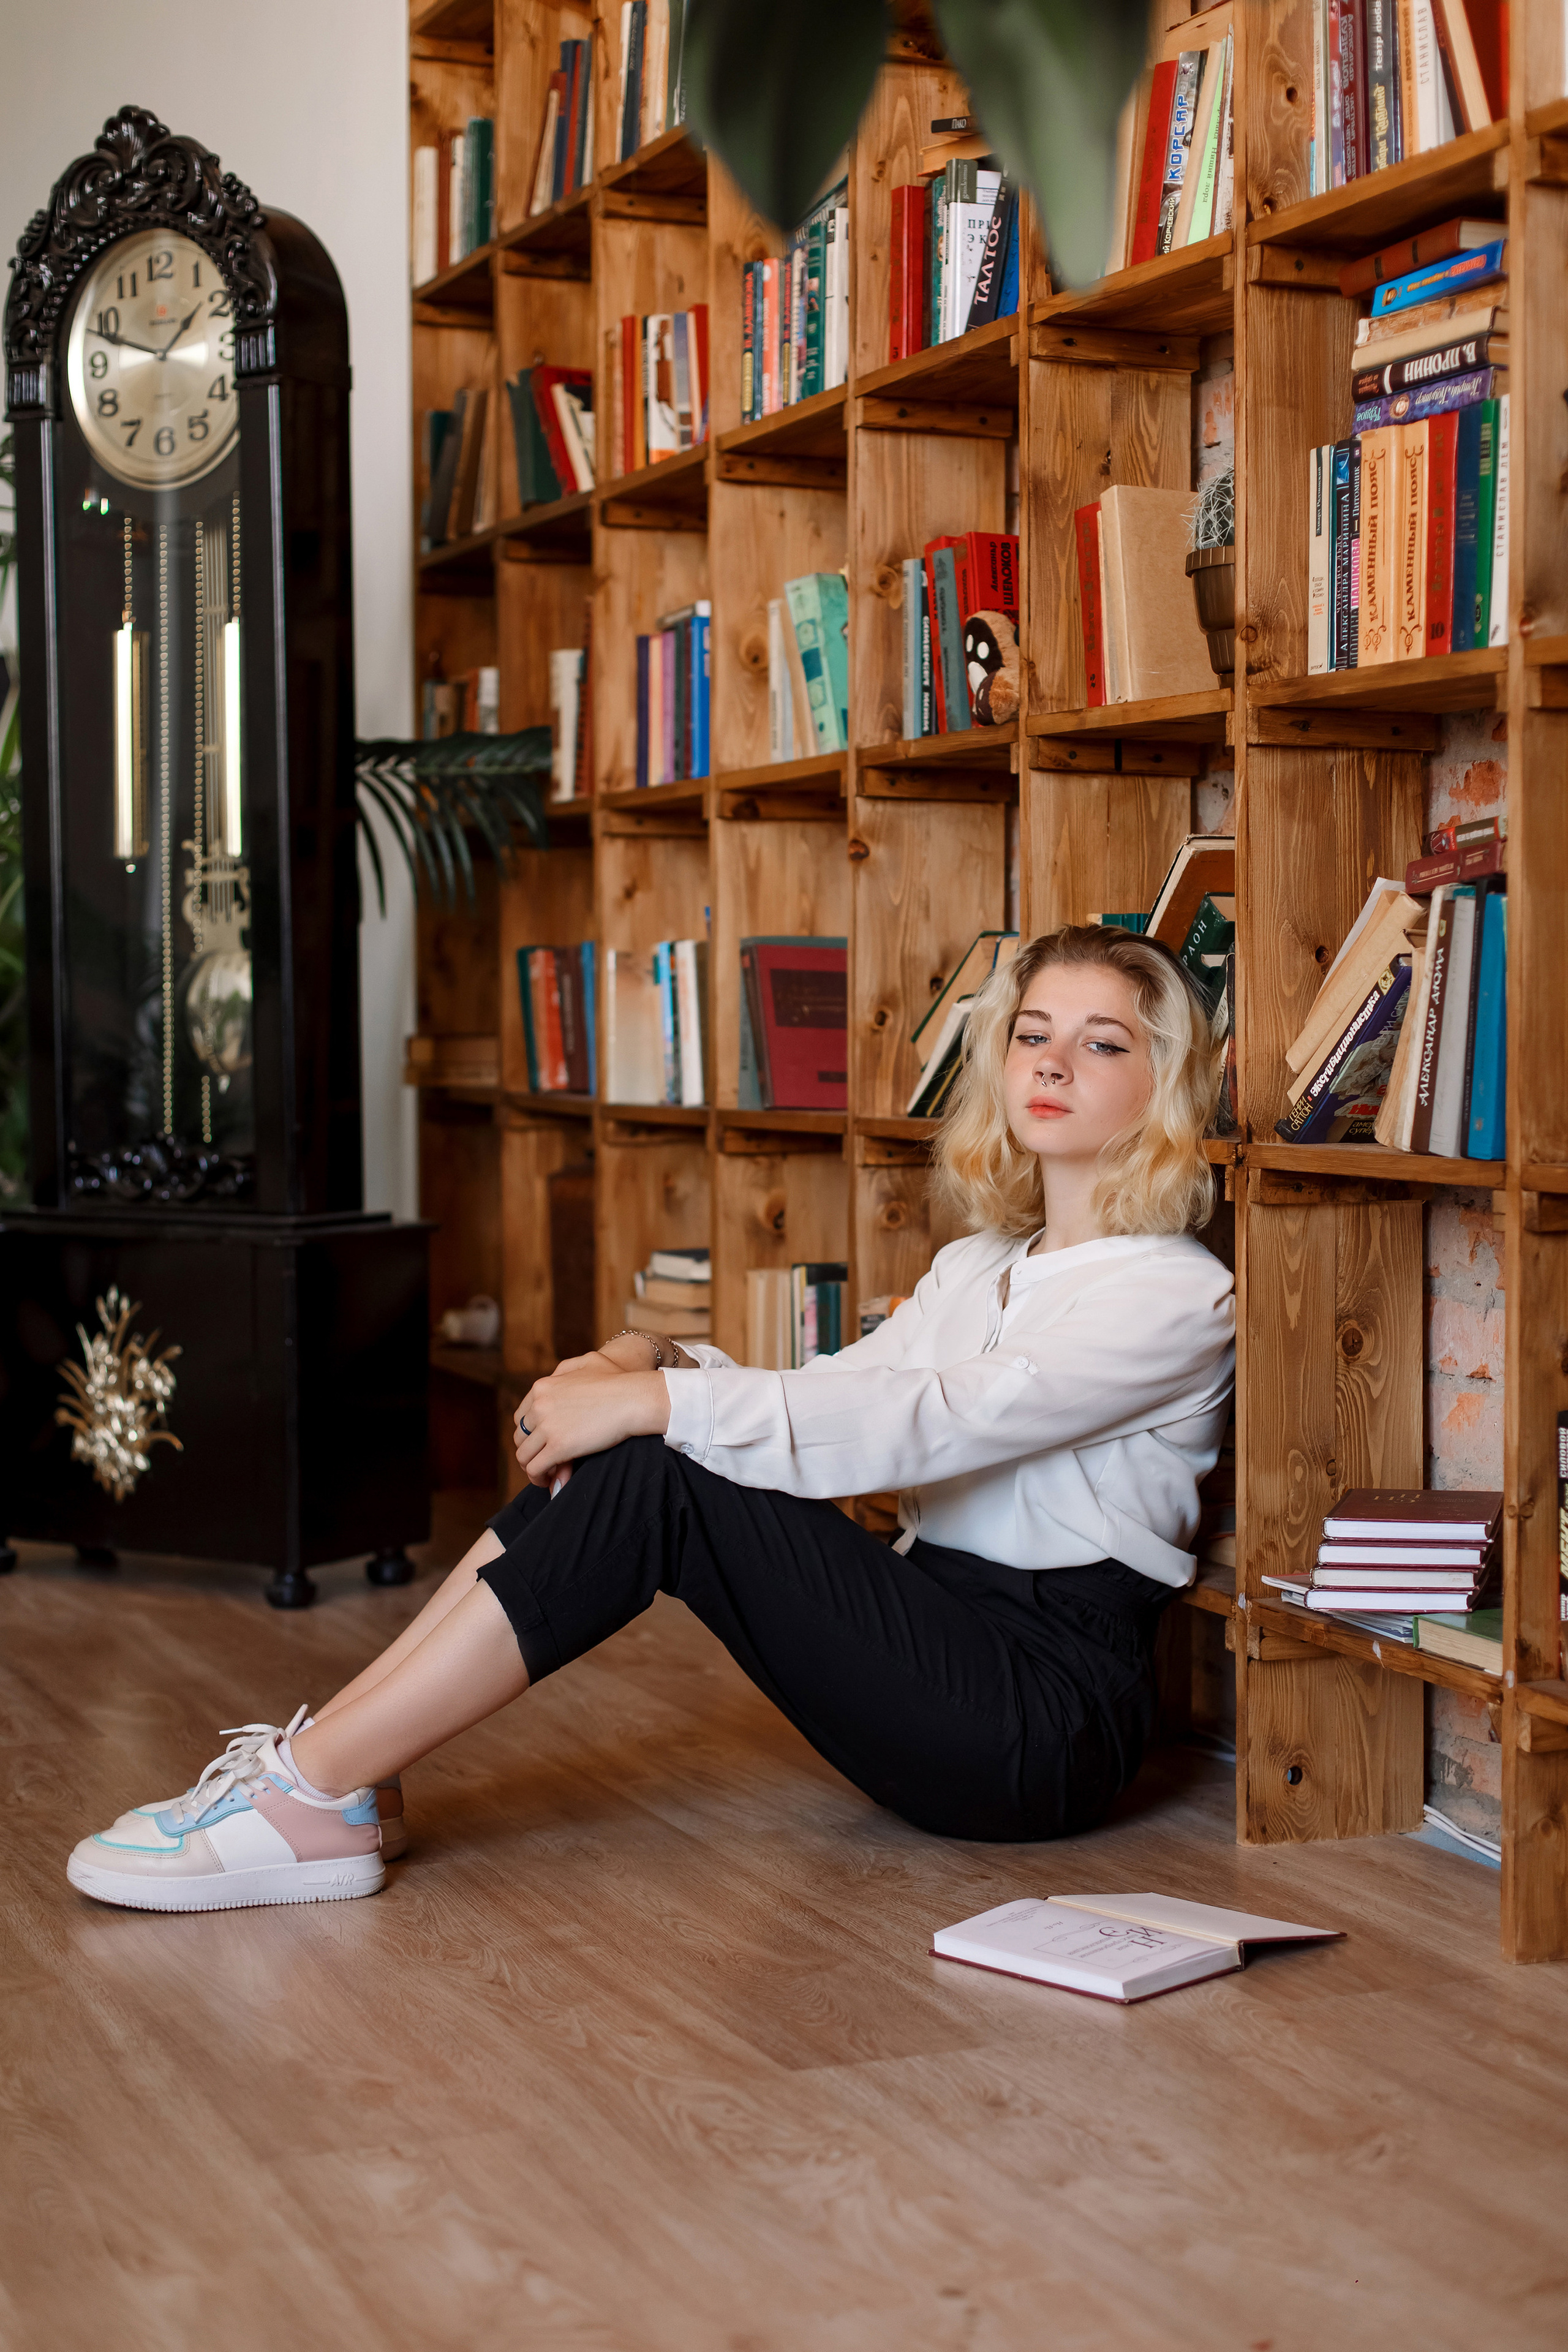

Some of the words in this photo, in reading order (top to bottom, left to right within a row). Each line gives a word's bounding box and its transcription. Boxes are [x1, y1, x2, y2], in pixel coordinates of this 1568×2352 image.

[1417, 7, 1430, 84] СТАНИСЛАВ
[1374, 83, 1389, 139] Картланд
[1167, 94, 1189, 181] КОРСАР
[1207, 148, 1218, 179] Нищий
[1202, 183, 1211, 203] лорд
[146, 250, 173, 282] 12
[192, 260, 202, 288] 1
[973, 216, 1002, 305] ТАЛТОС
[117, 271, 138, 299] 11
[208, 290, 230, 317] 2
[744, 271, 753, 334] ДАШКОВА
[97, 307, 119, 337] 10
[219, 331, 235, 361] 3
[1463, 341, 1476, 364] В.
[89, 350, 107, 379] 9
[1404, 347, 1460, 382] ПРОНИН
[97, 389, 119, 417] 8
[208, 375, 229, 402] 4
[1415, 385, 1450, 405] Коултер
[188, 409, 209, 441] 5
[1356, 405, 1381, 422] Герцог
[121, 419, 141, 447] 7
[153, 426, 176, 456] 6
[1500, 440, 1509, 469] ЛЕМ
[1368, 460, 1378, 508] ПОЯС
[1409, 457, 1419, 505] ПОЯС
[1340, 493, 1349, 566] МАРИНИНА
[1495, 477, 1508, 557] СТАНИСЛАВ
[1351, 538, 1360, 607] ДАШКОВА
[1367, 514, 1378, 622] КАМЕННЫЙ
[1405, 511, 1417, 621] КАМЕННЫЙ
[1340, 571, 1349, 650] АЛЕКСАНДРА
[1350, 609, 1359, 665] ПОЛИНА
[1371, 1020, 1396, 1050] ГЕНРИ
[1391, 986, 1411, 1017] САТТО
[1419, 1008, 1437, 1107] АЛЕКСАНДР
[1434, 947, 1445, 1006] ДЮМА
[1289, 1096, 1308, 1122] ГЕНРИ
[1290, 1102, 1313, 1131] САТТОН
